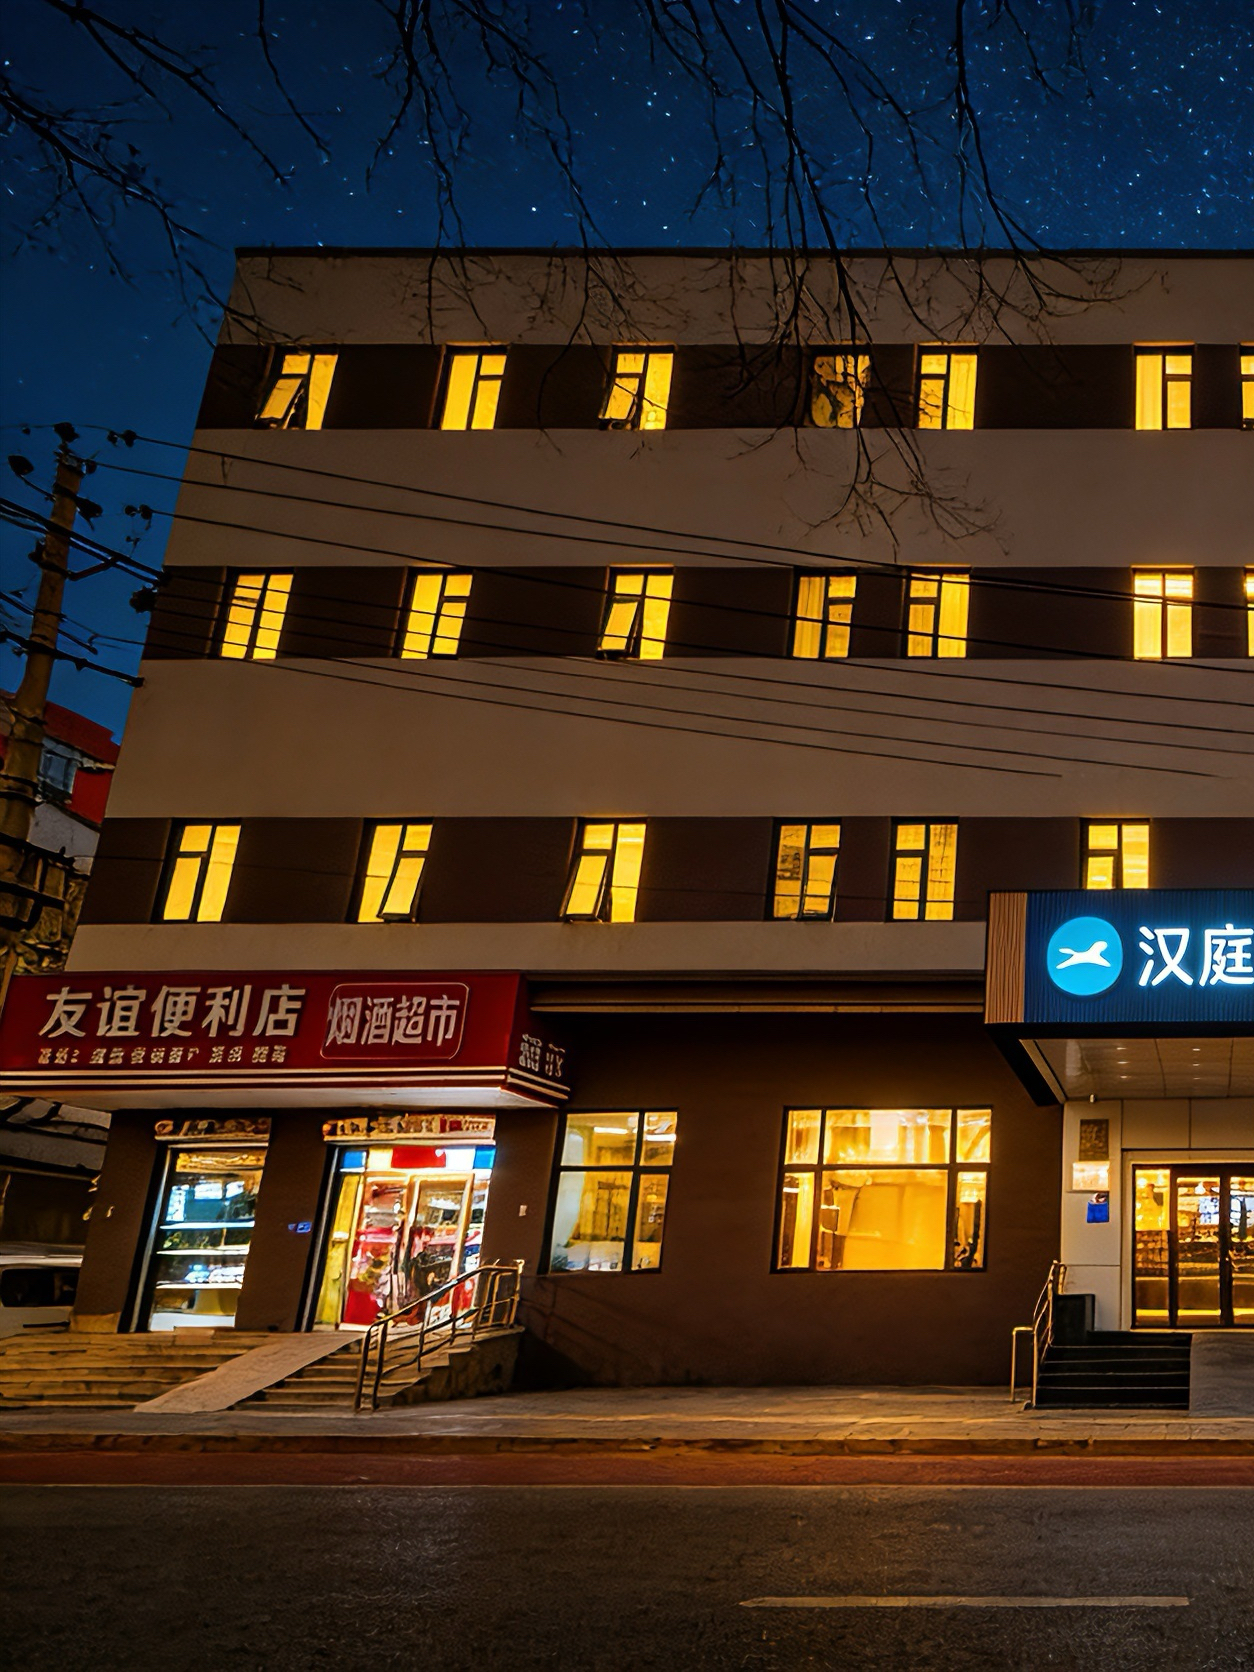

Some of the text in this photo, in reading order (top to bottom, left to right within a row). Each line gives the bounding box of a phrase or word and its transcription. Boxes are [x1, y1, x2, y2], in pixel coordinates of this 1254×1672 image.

[38, 984, 307, 1038] 友谊便利店
[327, 994, 460, 1047] 烟酒超市
